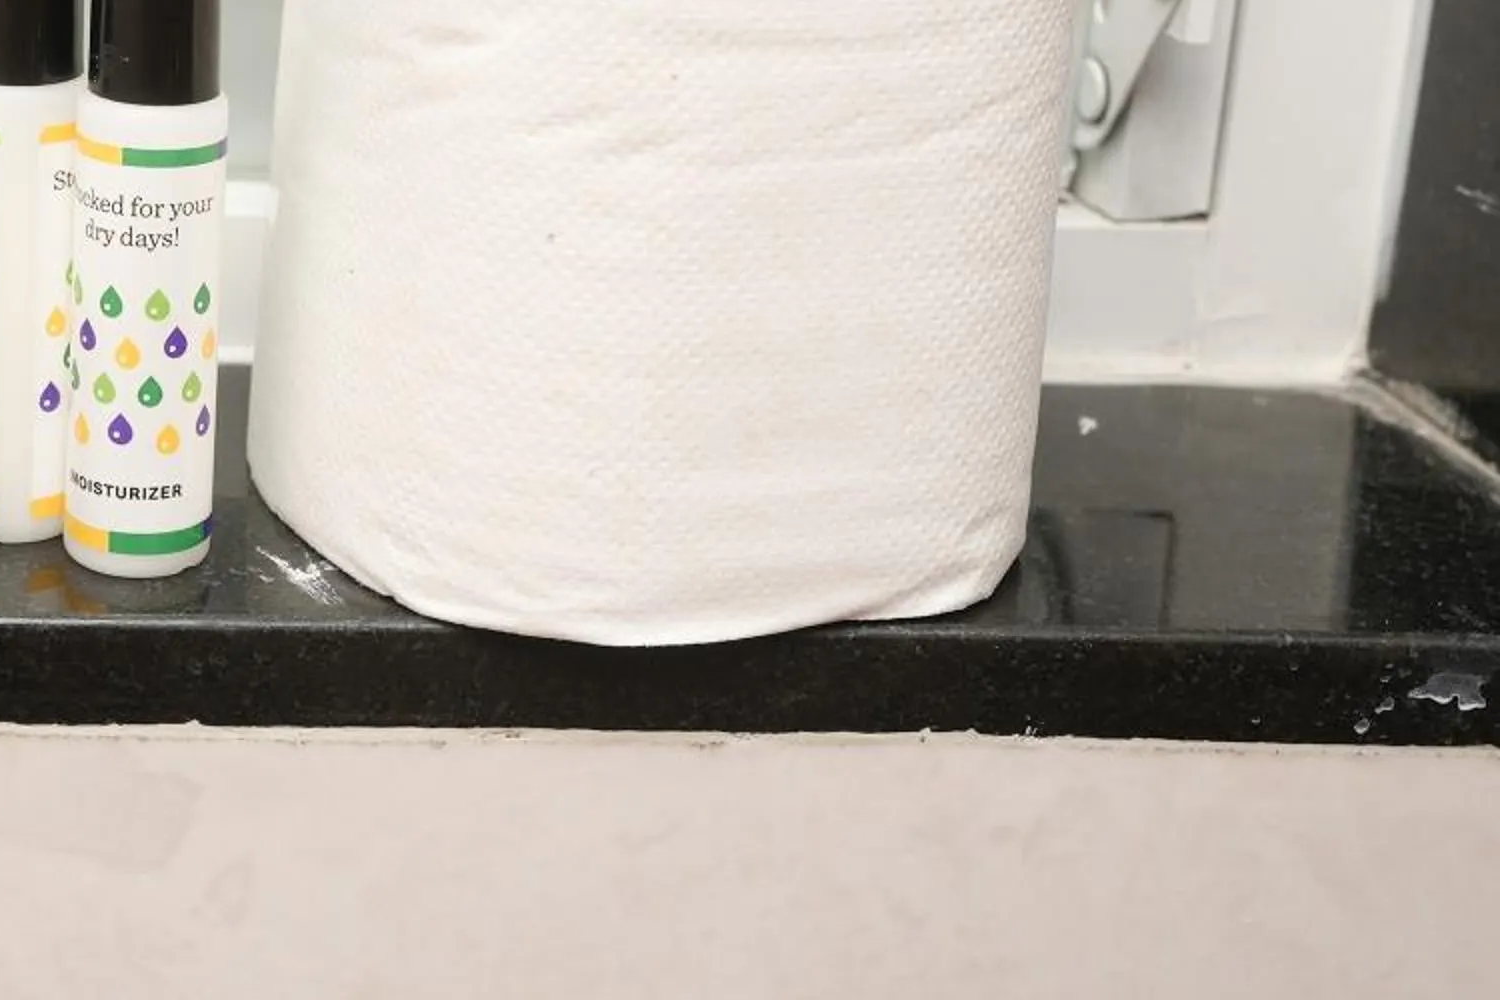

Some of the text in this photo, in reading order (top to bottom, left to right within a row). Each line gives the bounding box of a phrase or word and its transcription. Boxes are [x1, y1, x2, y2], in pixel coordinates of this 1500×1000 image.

[130, 196, 164, 218] for
[169, 196, 213, 221] your
[85, 218, 179, 252] dry days!
[70, 468, 182, 501] MOISTURIZER
